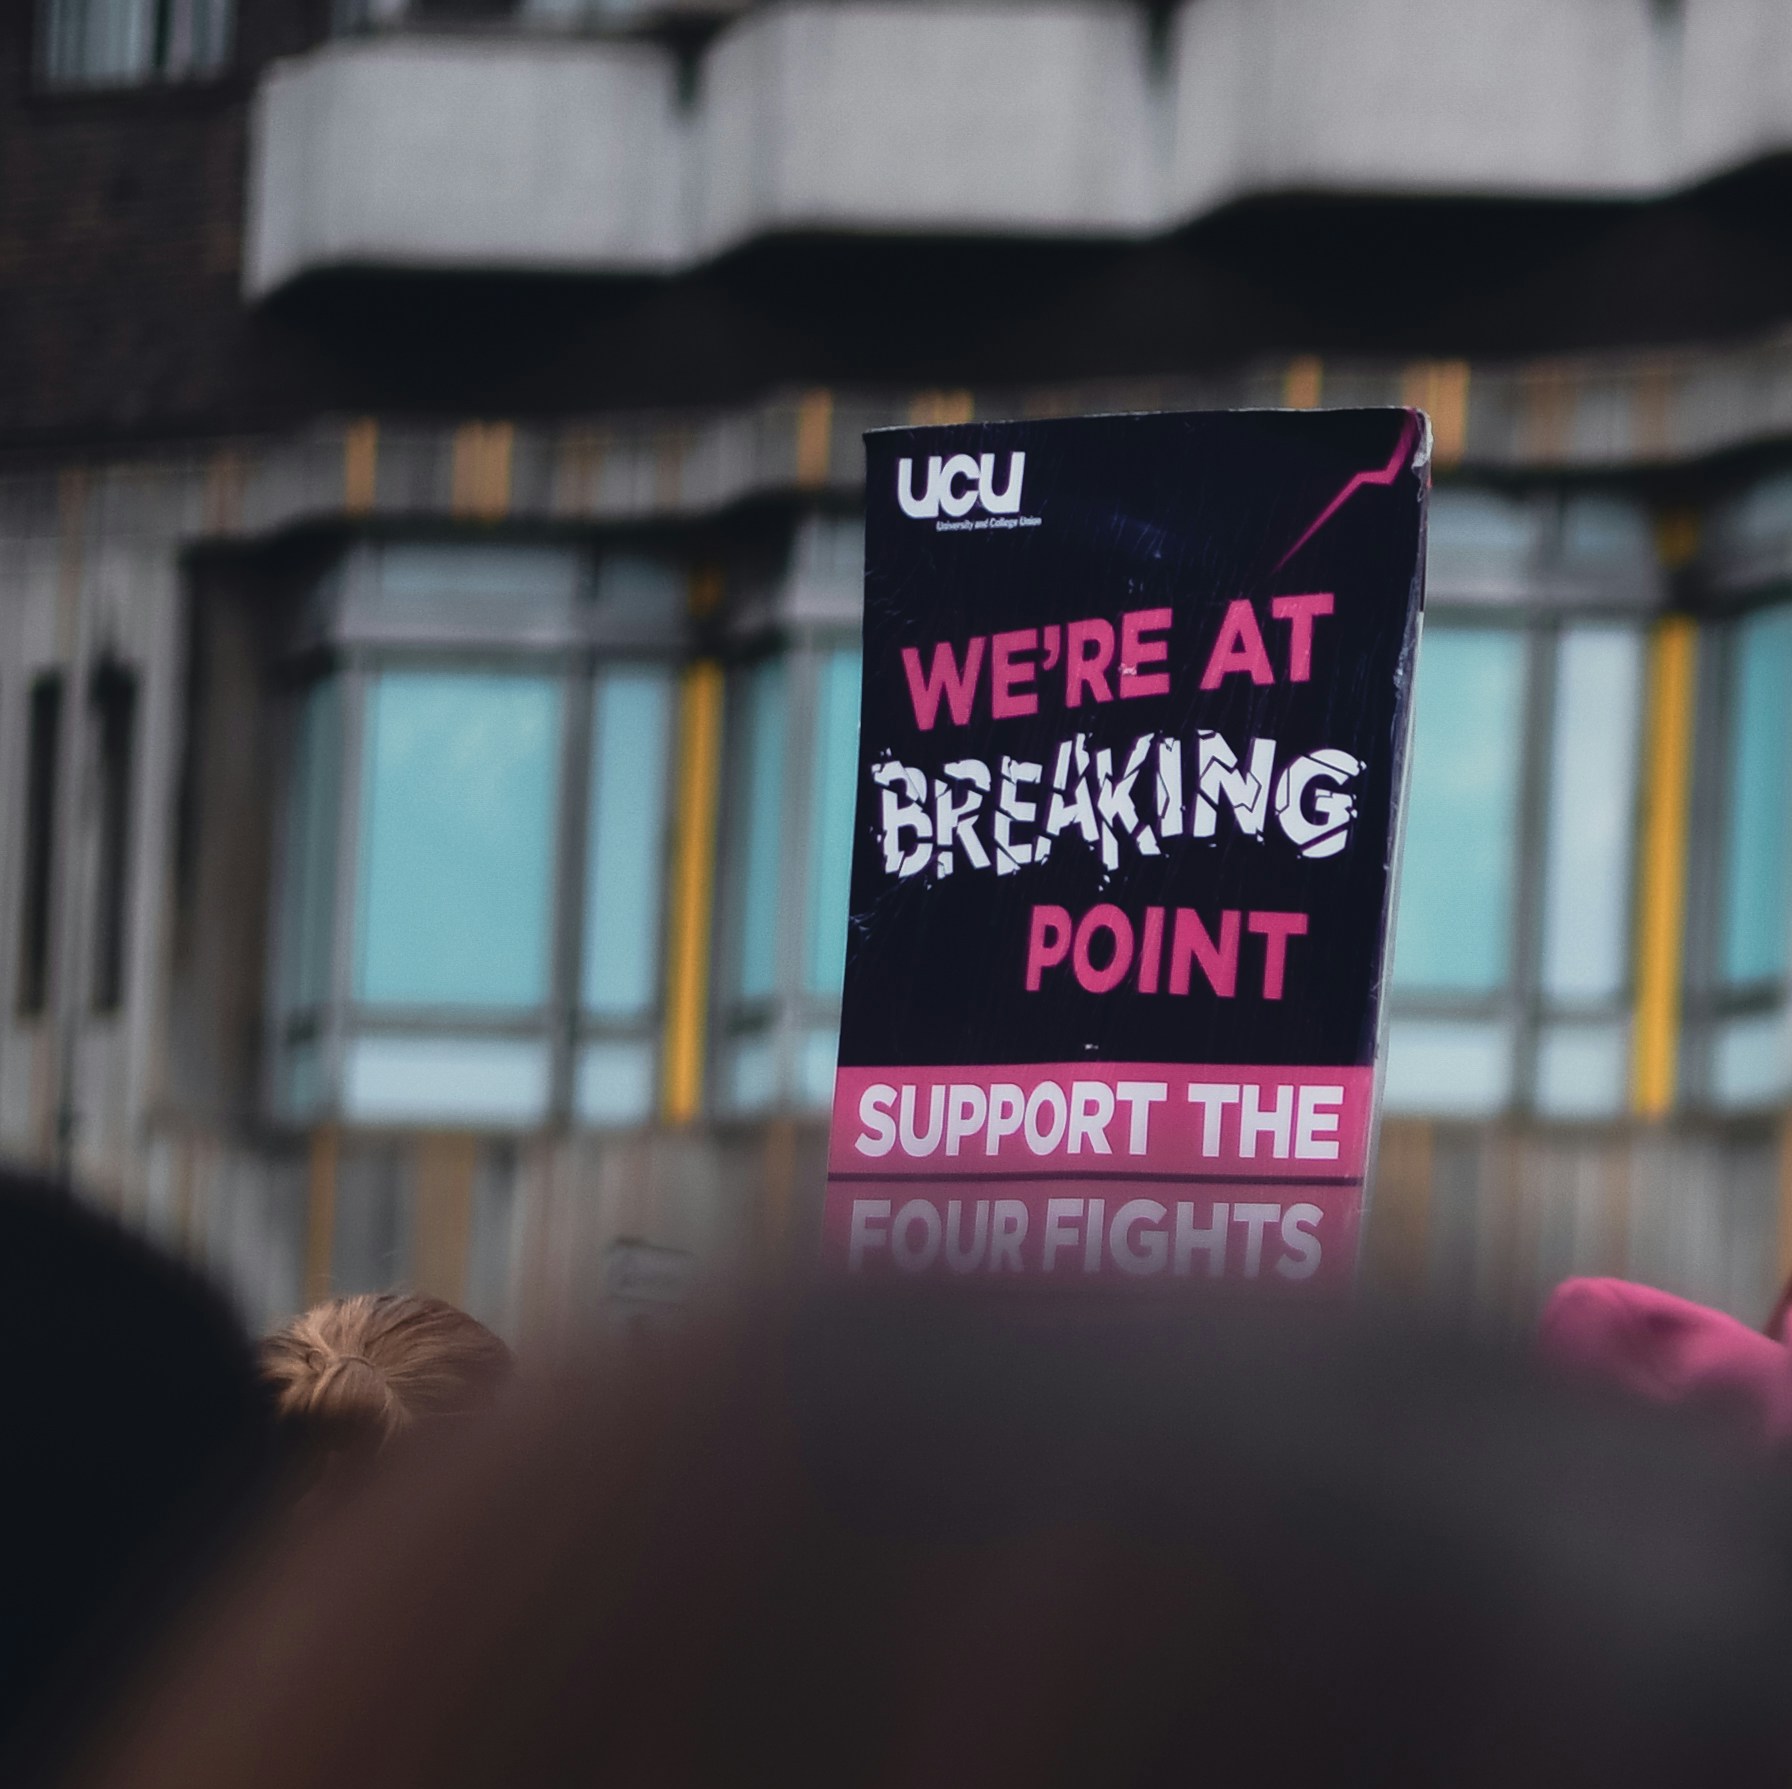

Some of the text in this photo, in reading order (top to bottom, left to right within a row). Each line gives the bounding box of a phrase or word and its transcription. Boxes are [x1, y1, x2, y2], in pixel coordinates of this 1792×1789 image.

[897, 451, 1026, 519] UCU
[902, 592, 1335, 730] WE'RE AT
[871, 728, 1366, 882] BREAKING
[1026, 903, 1309, 1000] POINT
[855, 1080, 1344, 1160] SUPPORT THE
[848, 1197, 1326, 1281] FOUR FIGHTS
